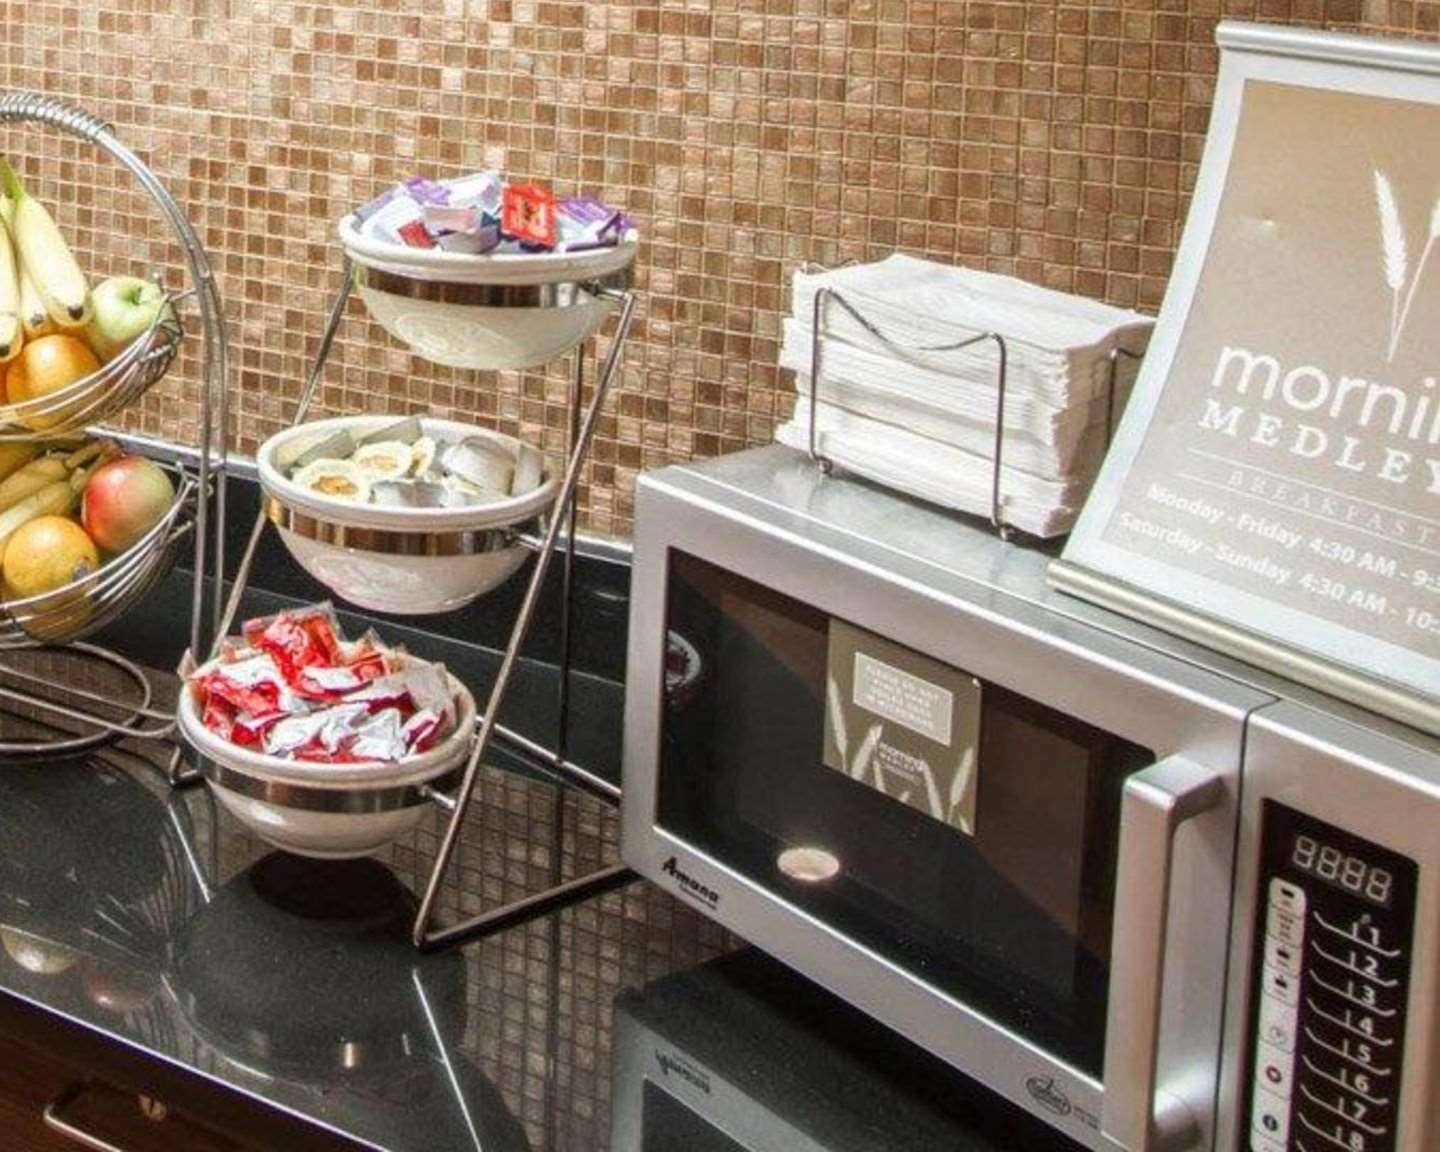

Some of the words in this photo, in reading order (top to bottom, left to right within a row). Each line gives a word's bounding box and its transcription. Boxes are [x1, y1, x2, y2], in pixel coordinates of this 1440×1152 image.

[1228, 470, 1436, 544] BREAKFAST
[1147, 483, 1225, 524] Monday
[1237, 513, 1303, 549] Friday
[1309, 537, 1356, 564] 4:30
[1357, 552, 1397, 578] AM
[1120, 511, 1203, 553] Saturday
[1215, 542, 1292, 584] Sunday
[1298, 573, 1346, 600] 4:30
[1346, 588, 1388, 615] AM
[1405, 607, 1440, 635] 10:
[662, 856, 719, 903] Amana
[1369, 926, 1380, 947] 1
[1363, 954, 1379, 976] 2
[1361, 984, 1376, 1006] 3
[1359, 1016, 1374, 1036] 4
[1357, 1044, 1371, 1064] 5
[1354, 1074, 1370, 1093] 6
[1352, 1101, 1367, 1120] 7
